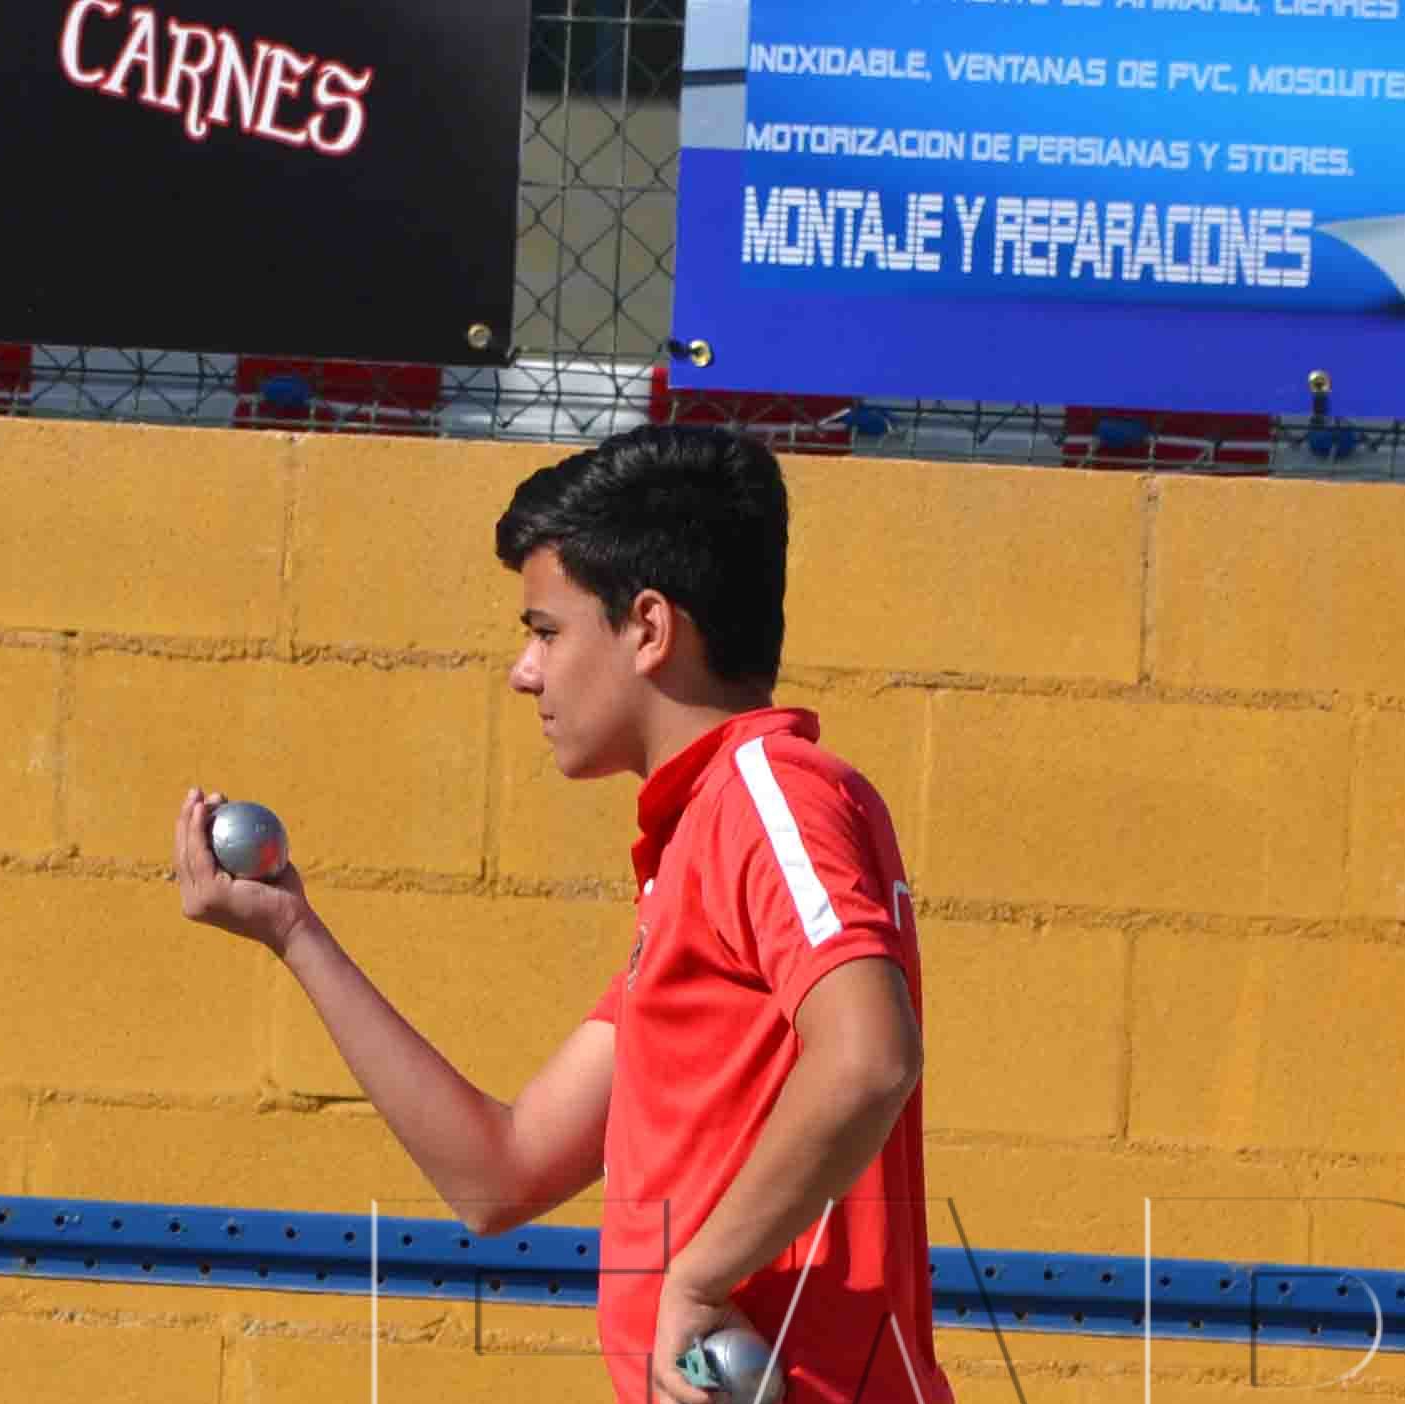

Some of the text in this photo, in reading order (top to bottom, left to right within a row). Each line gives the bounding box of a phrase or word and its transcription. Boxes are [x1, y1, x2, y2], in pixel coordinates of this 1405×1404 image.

[60, 0, 373, 155] CARNES
[750, 43, 932, 81] INOXIDABLE,
[945, 50, 1107, 86] VENTANAS
[1117, 60, 1158, 88] DE
[1168, 62, 1239, 94] PVC,
[746, 123, 1355, 177] MOTORIZACION DE PERSIANAS Y STORES.
[742, 186, 1313, 288] MONTAJE Y REPARACIONES
